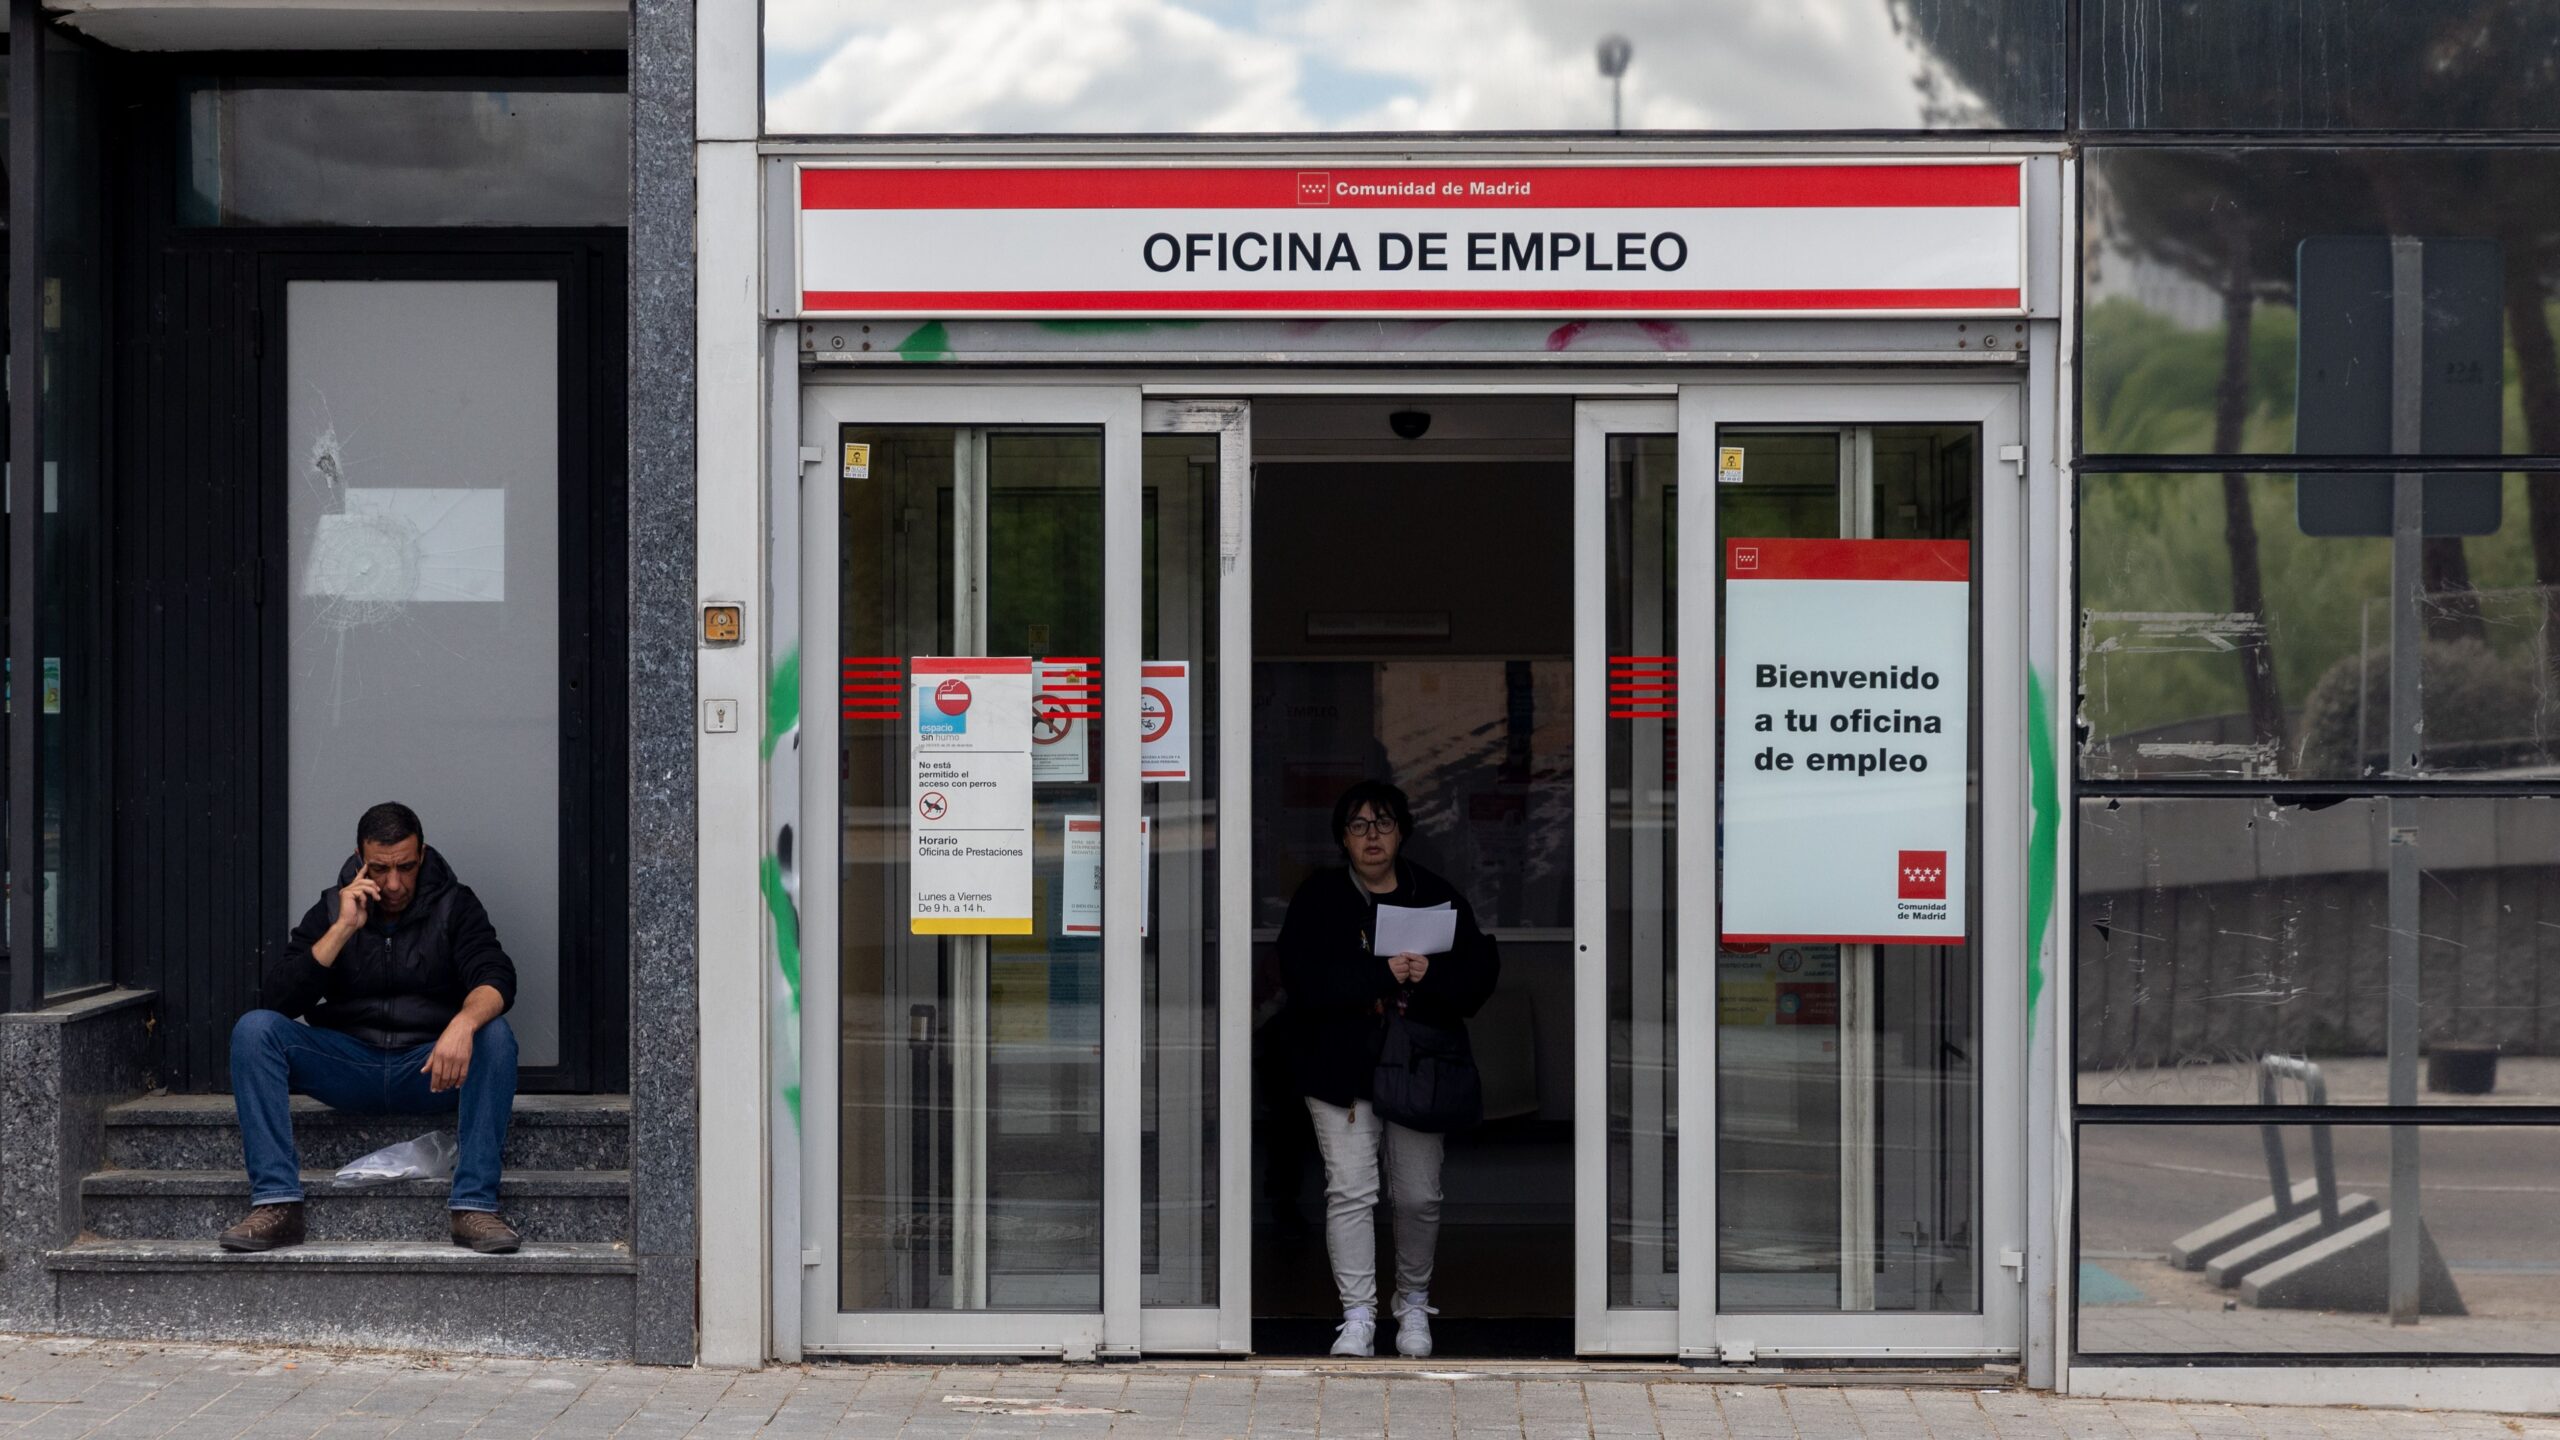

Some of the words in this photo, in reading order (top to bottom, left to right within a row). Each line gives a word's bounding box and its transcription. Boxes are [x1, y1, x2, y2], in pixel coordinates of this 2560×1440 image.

[1335, 181, 1436, 196] Comunidad
[1441, 181, 1464, 196] de
[1469, 181, 1532, 196] Madrid
[1143, 231, 1362, 273] OFICINA
[1378, 232, 1448, 272] DE
[1467, 231, 1688, 273] EMPLEO
[1755, 663, 1940, 690] Bienvenido
[1754, 713, 1773, 733] a
[1784, 708, 1818, 733] tu
[1829, 708, 1942, 734] oficina
[921, 723, 953, 734] espacio
[920, 733, 934, 741] sin
[935, 733, 960, 741] humo
[918, 761, 932, 769] No
[933, 761, 952, 769] está
[1754, 746, 1795, 772] de
[1806, 747, 1928, 777] empleo
[918, 770, 959, 780] permitido
[961, 770, 969, 779] el
[918, 780, 949, 788] acceso
[970, 781, 997, 789] perros
[919, 835, 958, 845] Horario
[918, 847, 950, 857] Oficina
[952, 847, 964, 857] de
[965, 847, 1024, 857] Prestaciones
[918, 892, 947, 902] Lunes
[949, 894, 956, 902] a
[957, 892, 993, 902] Viernes
[918, 904, 932, 913] De
[933, 903, 941, 913] 9
[942, 904, 952, 913] h.
[954, 905, 961, 913] a
[962, 903, 975, 913] 14
[976, 904, 986, 913] h.
[1897, 902, 1947, 911] Comunidad
[1897, 911, 1910, 920] de
[1912, 911, 1946, 921] Madrid
